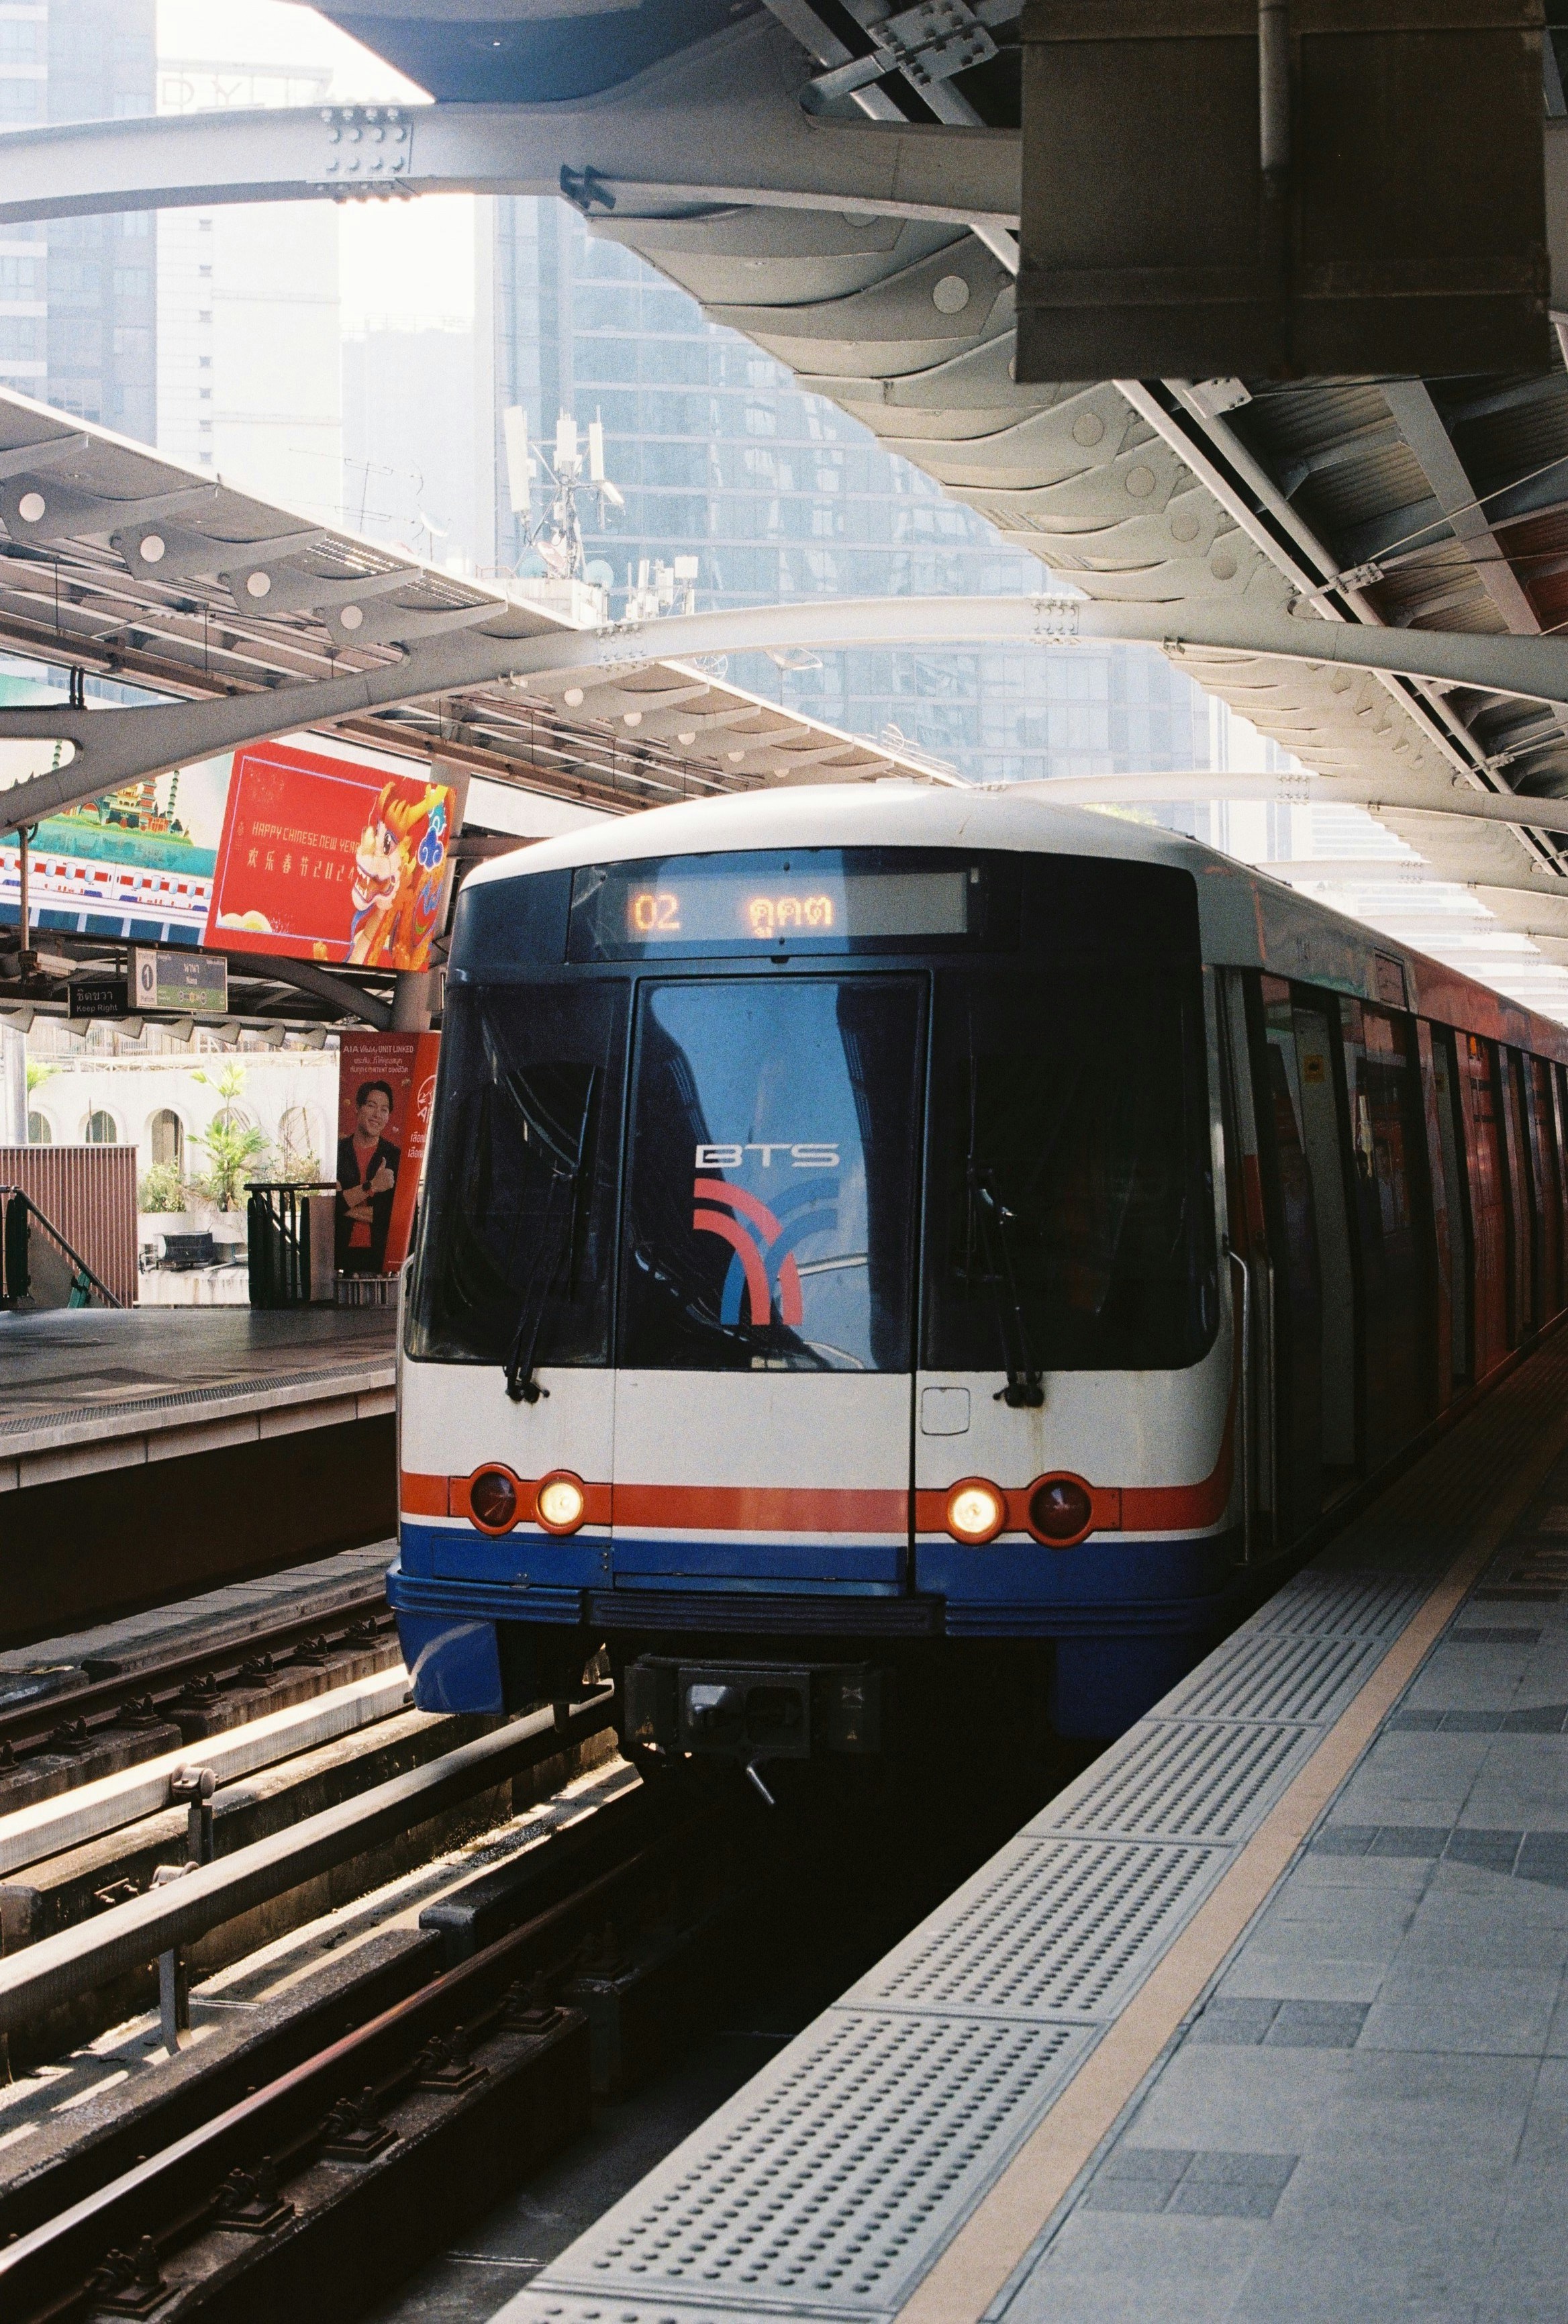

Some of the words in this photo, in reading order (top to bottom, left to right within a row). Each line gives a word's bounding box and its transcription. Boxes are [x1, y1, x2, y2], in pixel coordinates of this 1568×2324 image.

[252, 822, 283, 839] HAPPY
[283, 827, 319, 847] CHINESE
[319, 834, 338, 851] NEW
[634, 894, 680, 930] 02
[183, 963, 199, 973] นานา
[77, 988, 113, 1001] ชิดขวา
[77, 1005, 95, 1013] Keep
[97, 1004, 118, 1012] Right
[343, 1045, 358, 1053] AIA
[393, 1045, 414, 1053] LINKED
[695, 1143, 840, 1168] BTS
